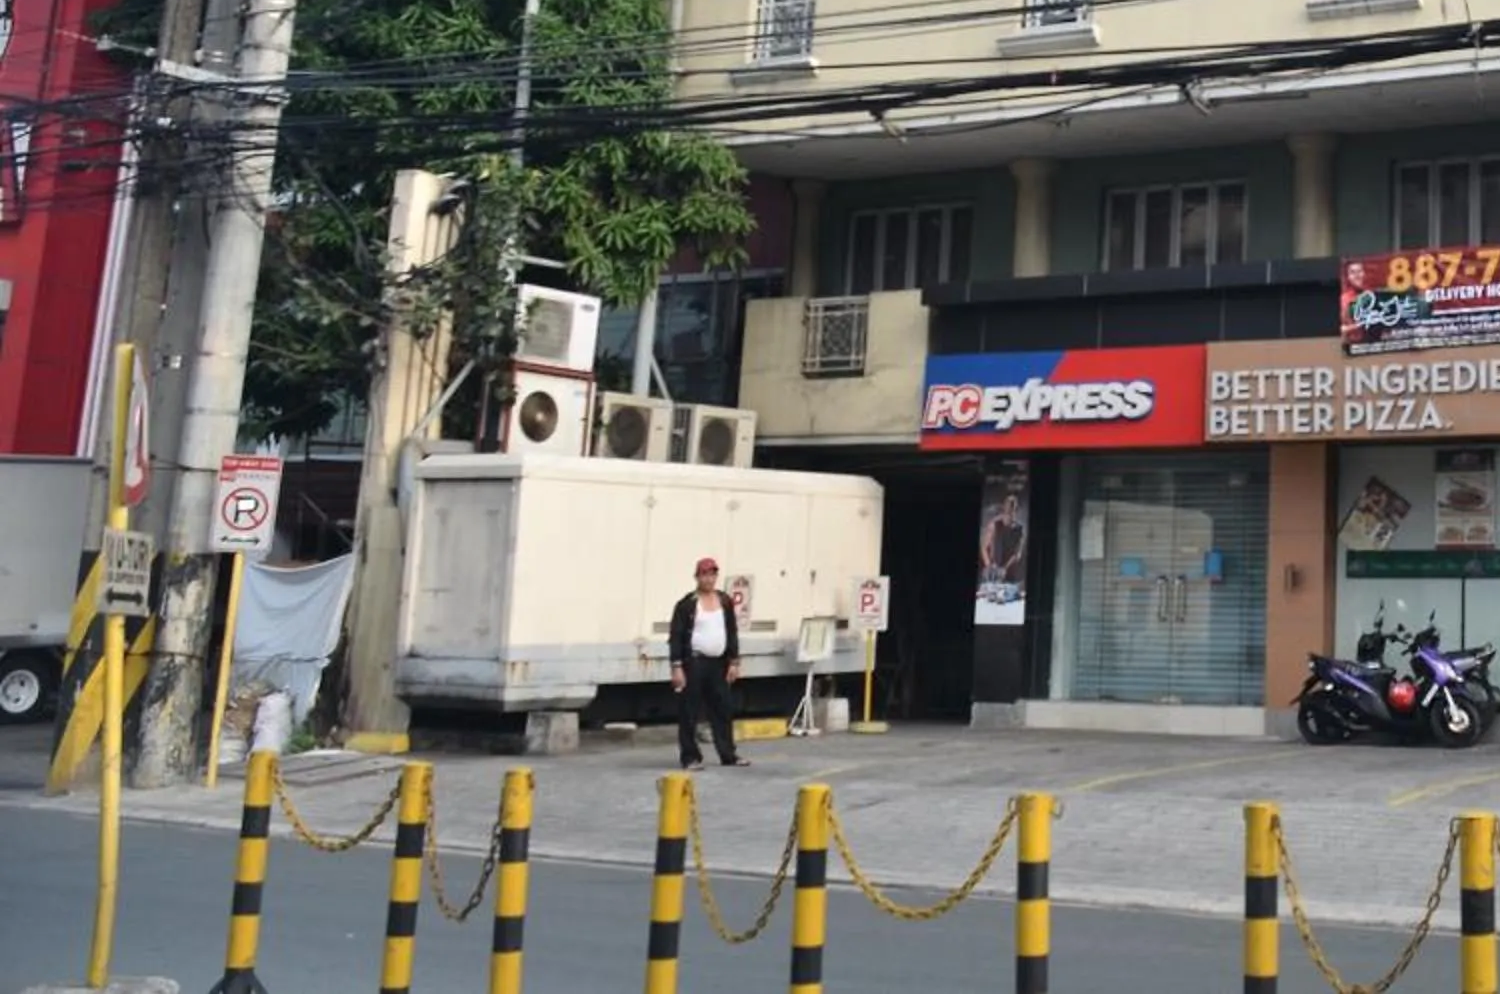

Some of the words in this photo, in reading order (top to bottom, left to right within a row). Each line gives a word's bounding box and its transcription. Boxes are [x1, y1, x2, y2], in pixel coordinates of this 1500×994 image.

[1425, 285, 1484, 303] DELIVERY
[1211, 366, 1336, 401] BETTER
[1209, 400, 1336, 436] BETTER
[1344, 399, 1454, 432] PIZZA.
